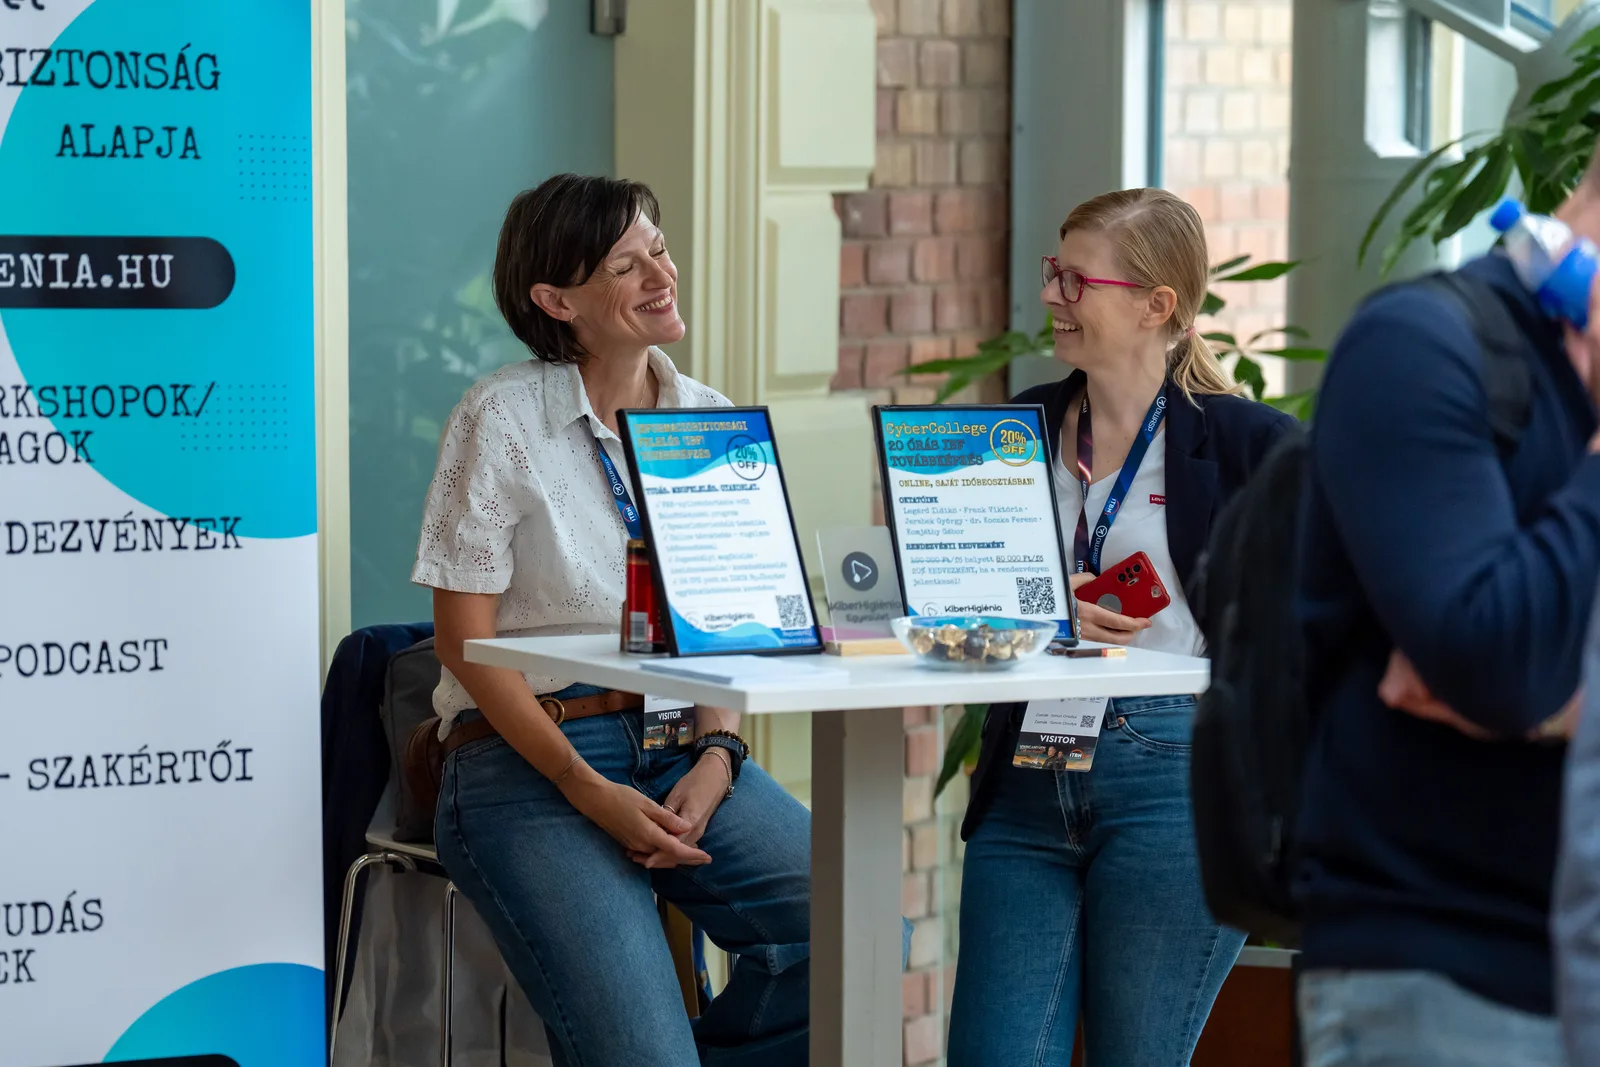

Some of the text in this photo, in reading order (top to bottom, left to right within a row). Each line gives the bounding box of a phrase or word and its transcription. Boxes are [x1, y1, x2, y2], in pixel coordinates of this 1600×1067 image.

[0, 43, 220, 91] IZTONSÁG
[56, 123, 201, 160] ALAPJA
[0, 252, 174, 289] ENIA.HU
[1147, 407, 1163, 433] OWASP
[886, 421, 988, 438] CyberCollege
[1000, 429, 1027, 445] 20%
[888, 439, 904, 451] 20
[907, 437, 939, 451] ÓRÁS
[1001, 444, 1026, 456] OFF
[735, 444, 758, 460] 20%
[889, 452, 985, 467] TOVÁBBKÉPZÉS
[737, 460, 758, 470] OFF
[898, 476, 1036, 489] ONLINE, SAJÁT IDŐBEOSZTÁSBAN!
[970, 516, 982, 524] dr.
[958, 540, 1005, 550] KEDVEZMÉNY
[944, 603, 1003, 614] KiberHigiénia
[0, 638, 168, 678] PODCAST
[657, 711, 682, 720] VISITOR
[1040, 735, 1076, 744] VISITOR
[28, 740, 254, 791] SZAKÉRTŐI
[2, 890, 104, 937] UDÁS
